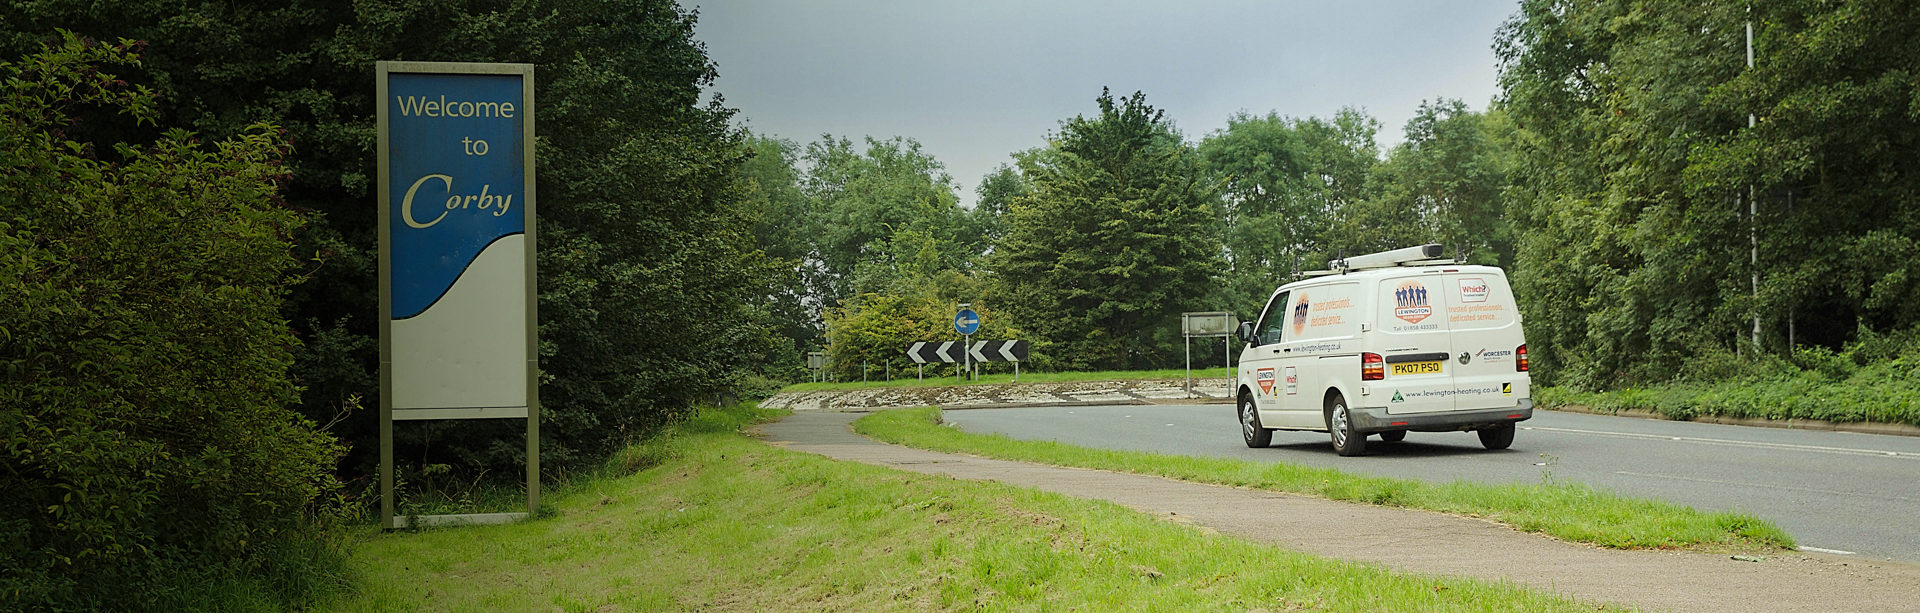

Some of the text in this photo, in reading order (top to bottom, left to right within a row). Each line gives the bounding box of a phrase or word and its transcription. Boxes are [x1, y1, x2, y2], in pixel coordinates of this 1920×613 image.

[397, 95, 515, 118] Welcome
[462, 136, 489, 156] to
[401, 173, 512, 229] Corby
[1462, 285, 1486, 293] Which?
[1450, 314, 1476, 322] dedicated
[1395, 363, 1419, 374] PK07
[1405, 386, 1500, 398] www.lewington-heating.co.uk
